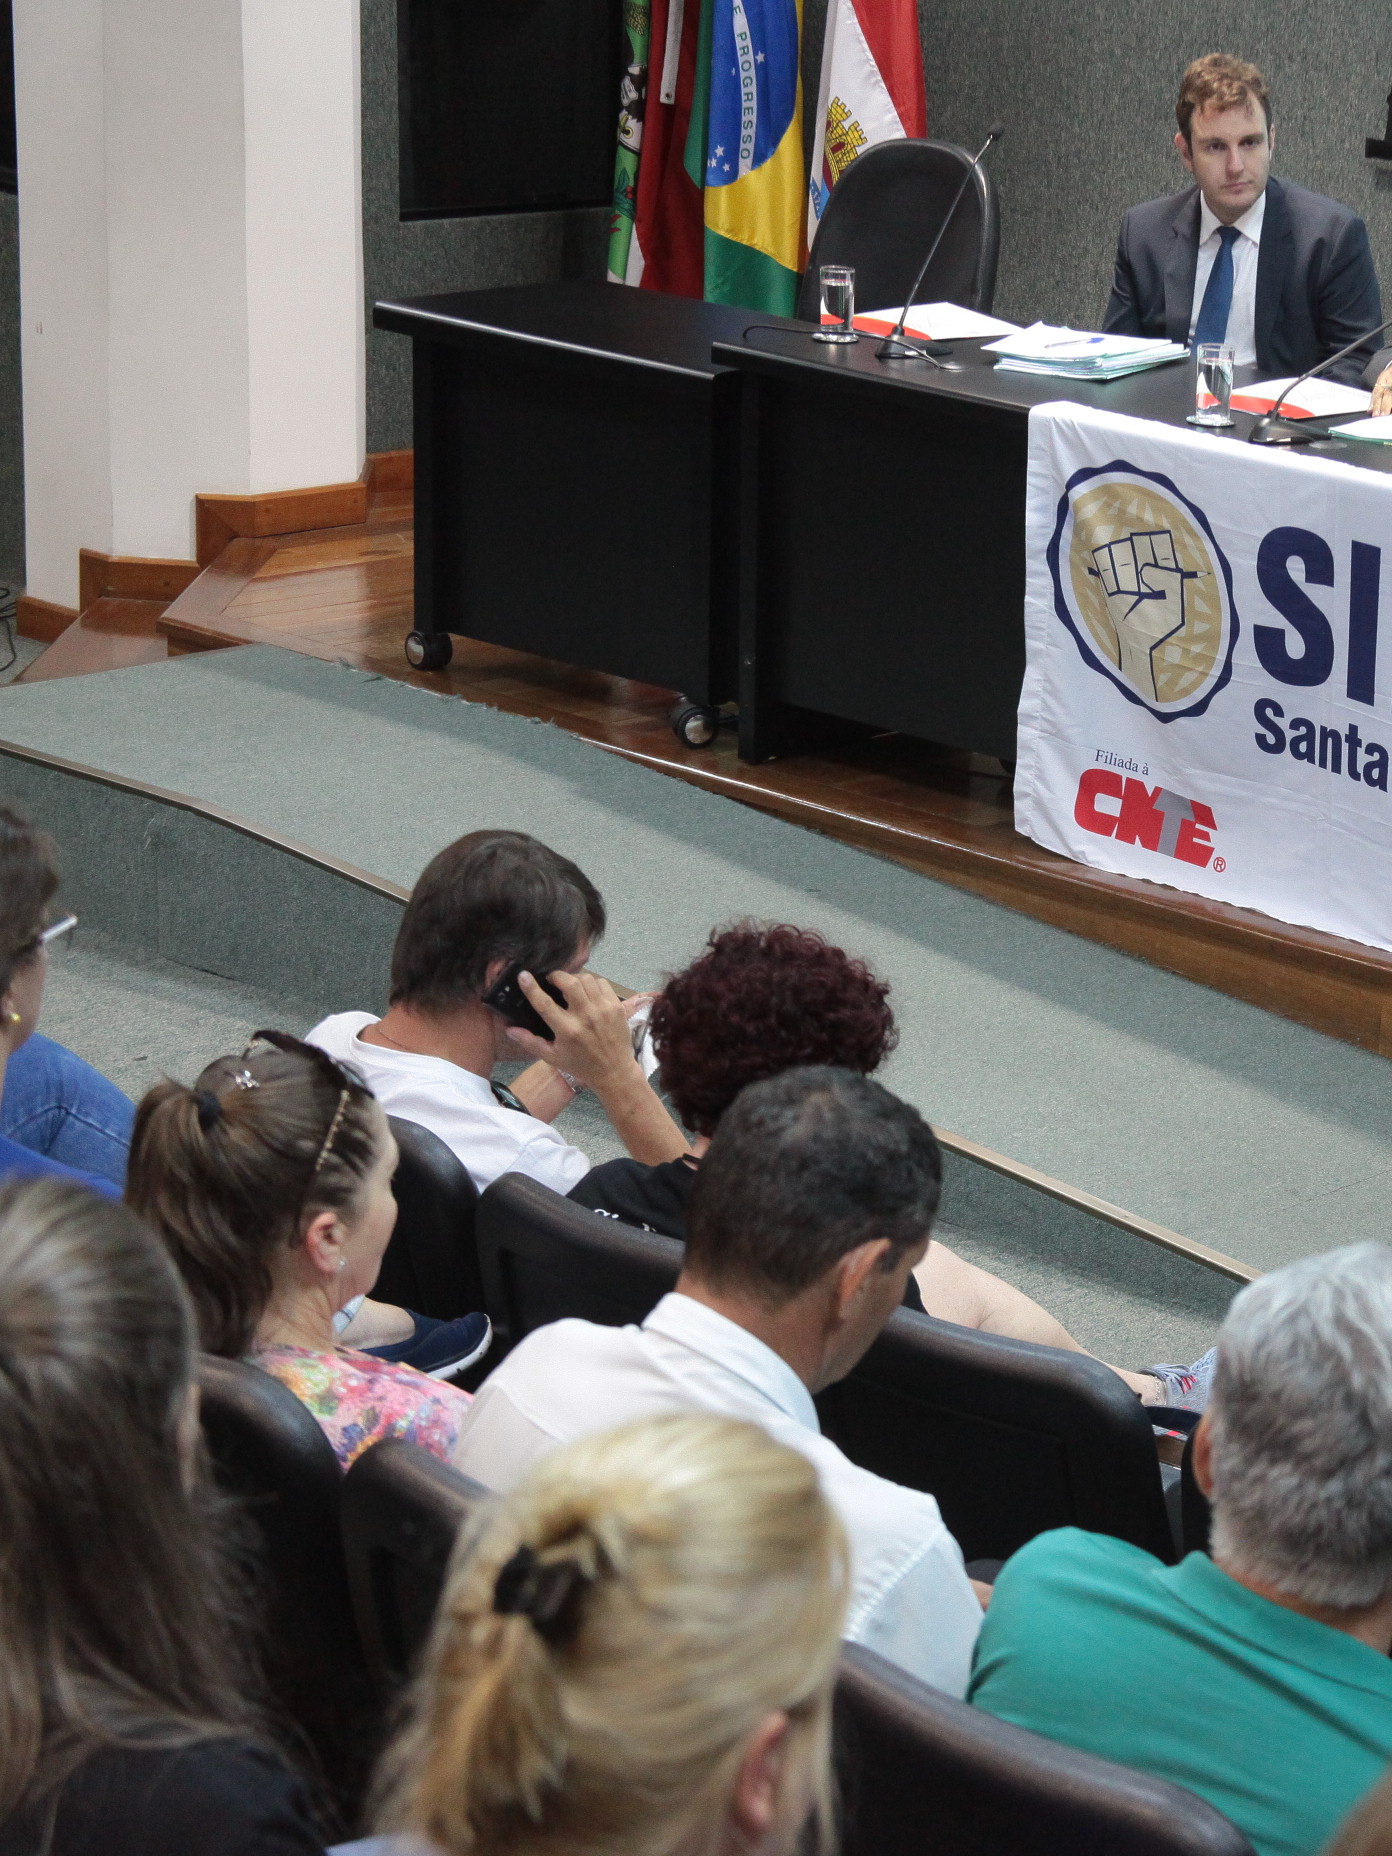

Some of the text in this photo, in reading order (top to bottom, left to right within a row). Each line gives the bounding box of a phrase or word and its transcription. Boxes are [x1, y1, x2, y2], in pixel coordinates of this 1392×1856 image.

[737, 31, 754, 160] PROGRESSO
[1094, 748, 1150, 776] Filiada à
[1253, 697, 1390, 793] Santa
[1073, 768, 1219, 869] CNTE
